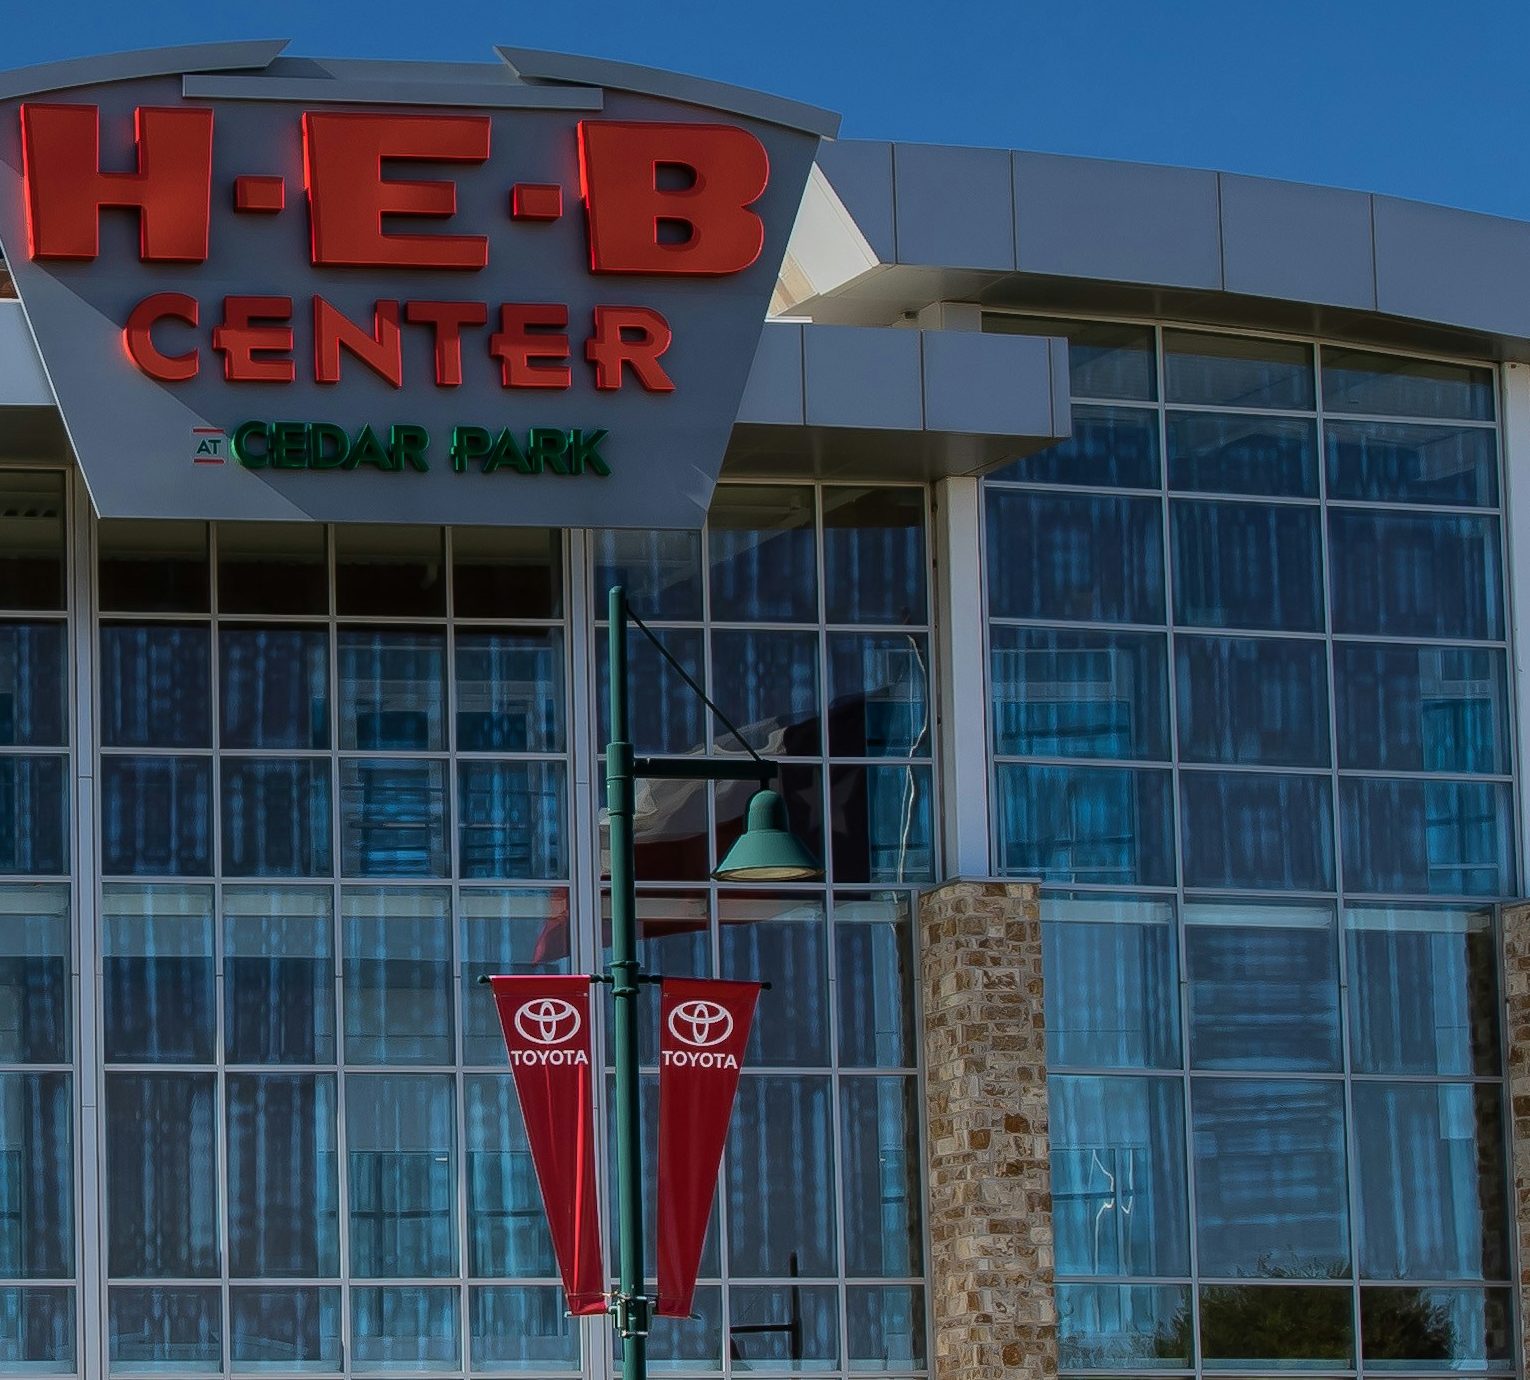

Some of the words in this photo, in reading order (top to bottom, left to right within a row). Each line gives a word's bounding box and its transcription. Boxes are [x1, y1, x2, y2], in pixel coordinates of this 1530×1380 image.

[122, 291, 676, 393] CENTER
[196, 438, 222, 456] AT
[230, 419, 431, 474] CEDAR
[449, 424, 613, 477] PARK
[511, 1049, 589, 1067] TOYOTA
[662, 1050, 739, 1070] TOYOTA
